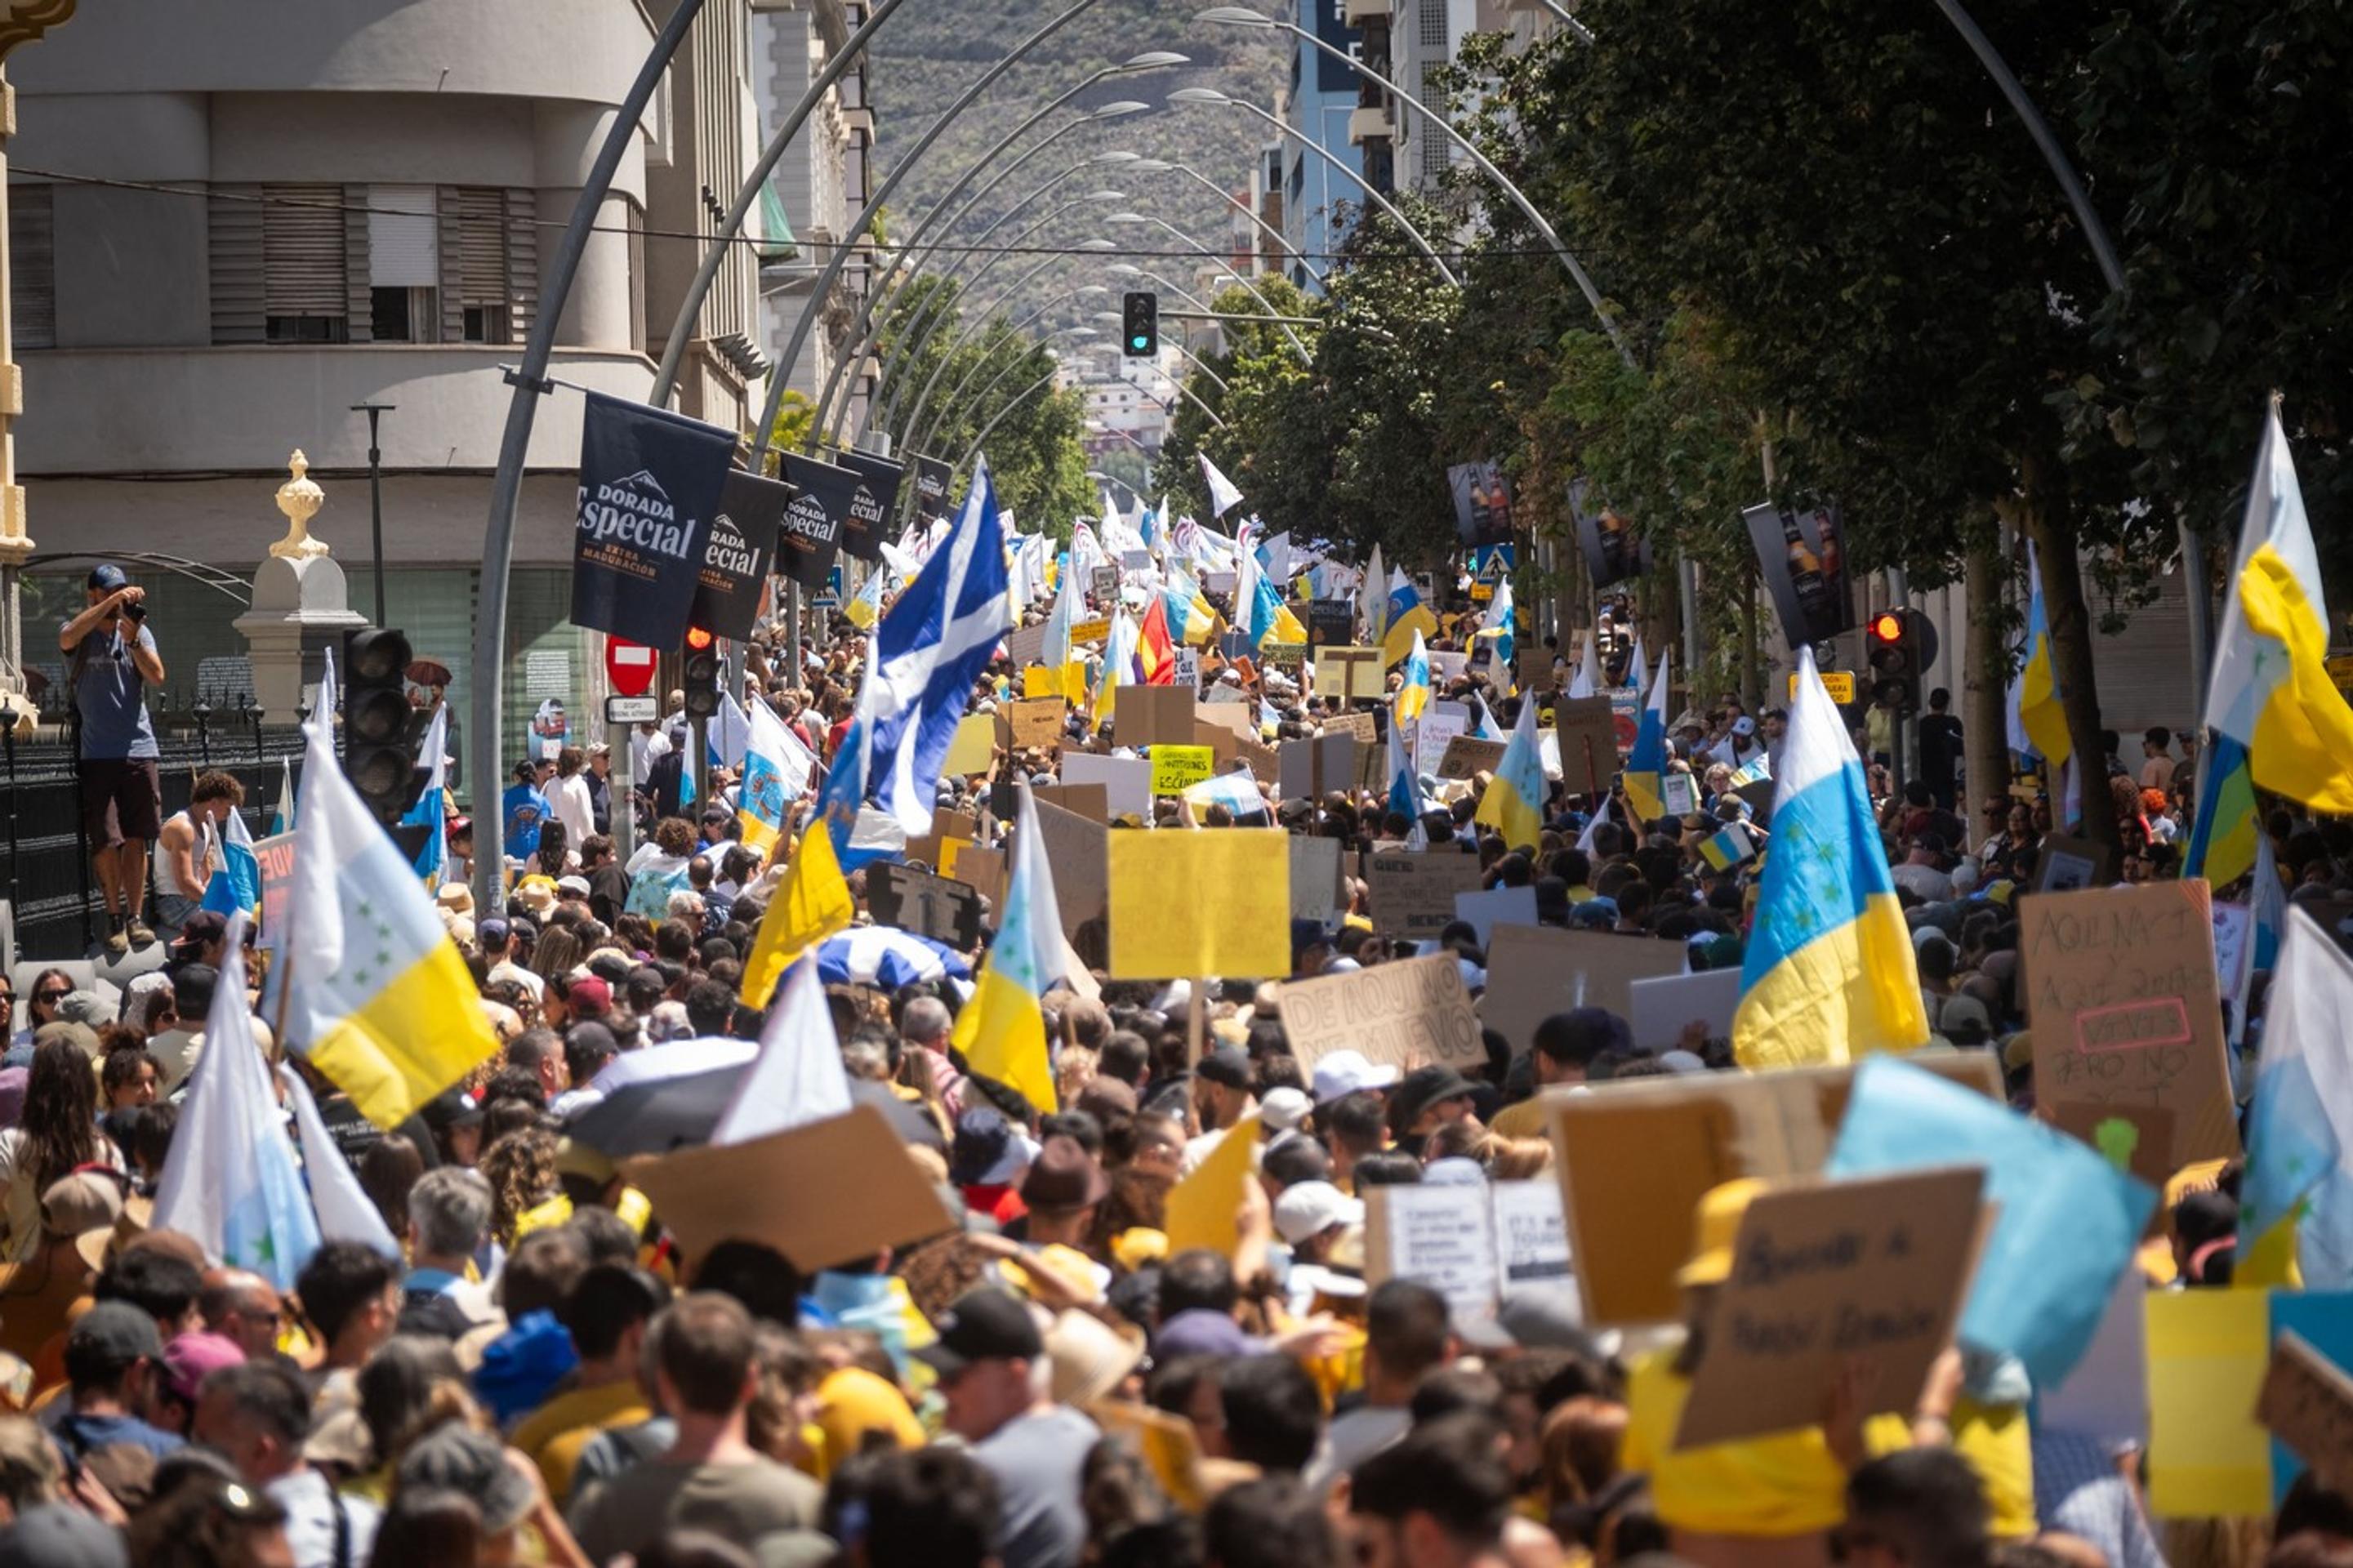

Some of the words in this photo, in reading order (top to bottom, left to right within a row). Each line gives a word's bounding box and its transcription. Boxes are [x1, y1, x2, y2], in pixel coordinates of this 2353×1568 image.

[598, 484, 675, 521] DORADA
[787, 501, 827, 522] DORADA
[849, 502, 884, 523] ecial
[853, 493, 876, 507] RADA
[781, 510, 838, 542] special
[604, 543, 639, 562] EXTRA
[710, 530, 746, 550] RADA
[705, 543, 760, 577] ecial
[1284, 986, 1338, 1037] DE
[1413, 956, 1462, 1009] NO
[2142, 1048, 2190, 1080] NO
